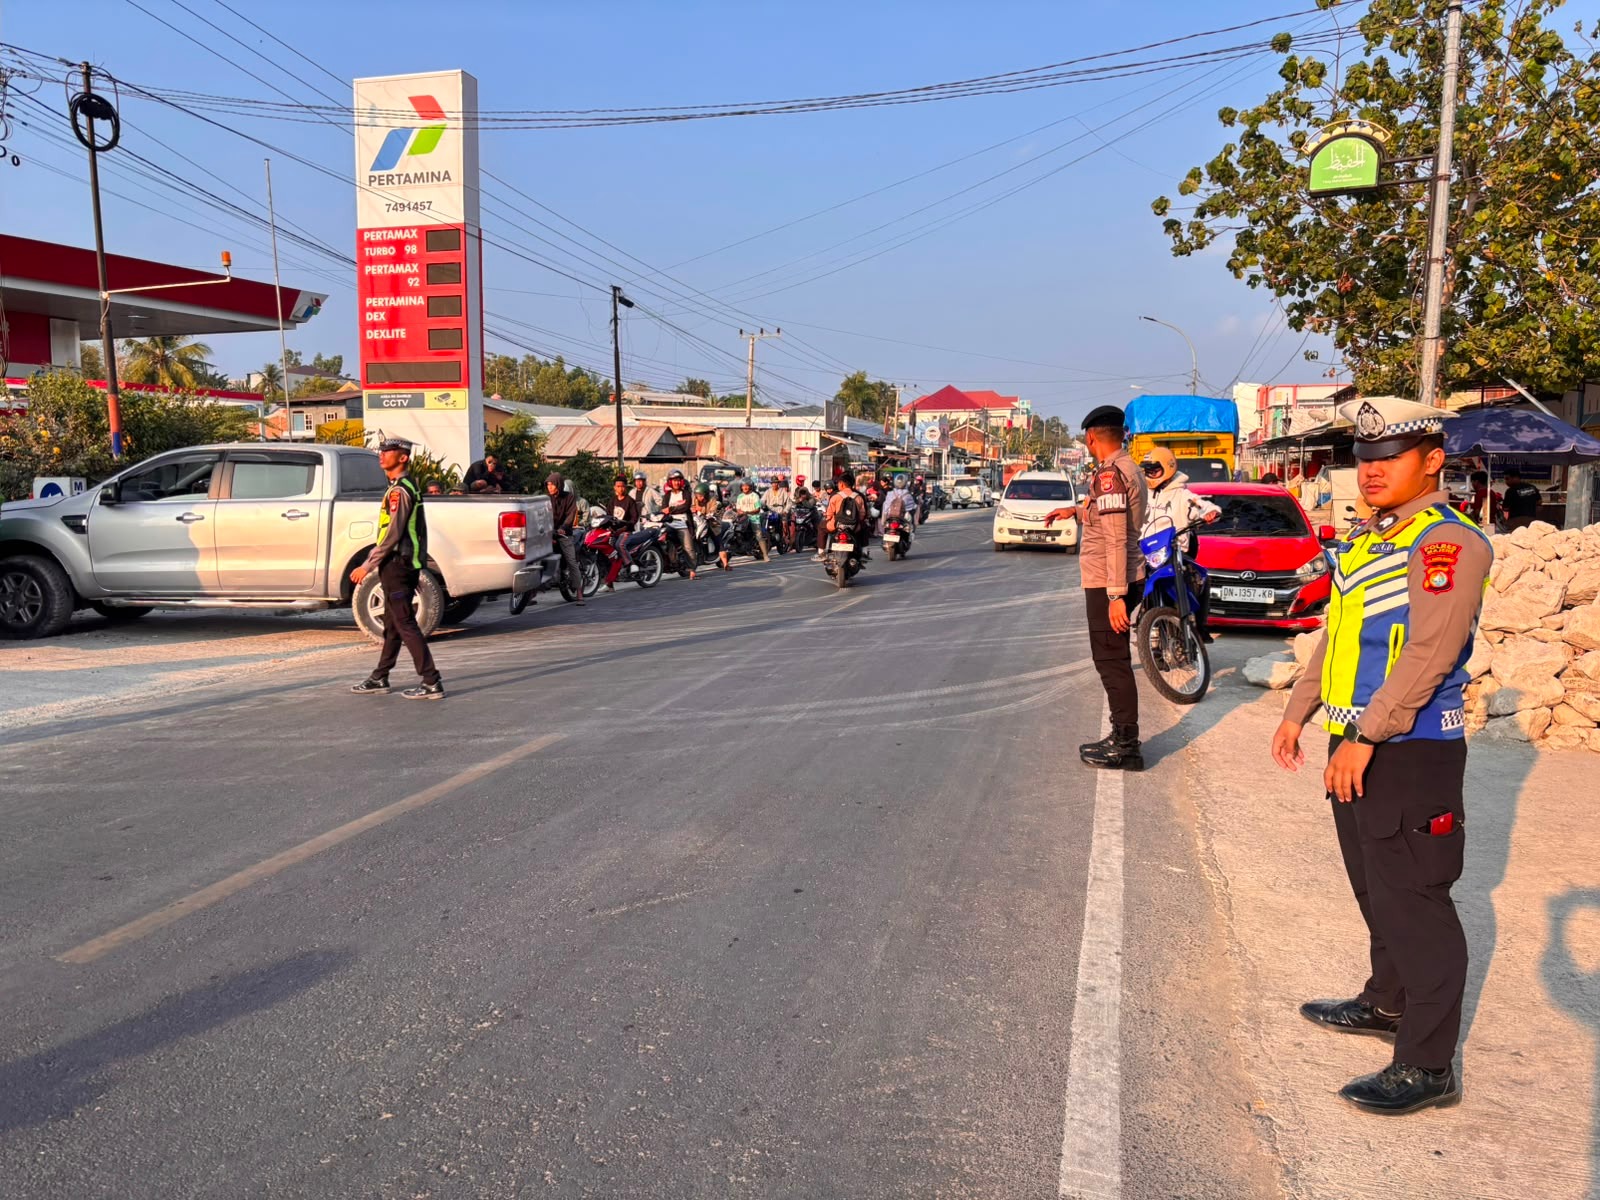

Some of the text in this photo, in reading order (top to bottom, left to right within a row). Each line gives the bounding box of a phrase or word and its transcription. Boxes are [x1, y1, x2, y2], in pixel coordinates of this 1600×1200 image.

[368, 170, 452, 187] PERTAMINA
[385, 201, 433, 213] 7491457
[364, 228, 418, 241] PERTAMAX
[364, 244, 417, 257] TURBO 98
[365, 263, 419, 275] PERTAMAX
[407, 277, 420, 287] 92
[366, 296, 425, 307] PERTAMINA
[366, 311, 386, 321] DEX
[366, 329, 406, 339] DEXLITE
[383, 399, 409, 407] CCTV
[1423, 543, 1457, 552] POLRES
[1223, 587, 1234, 597] DN
[1239, 588, 1257, 598] 1357
